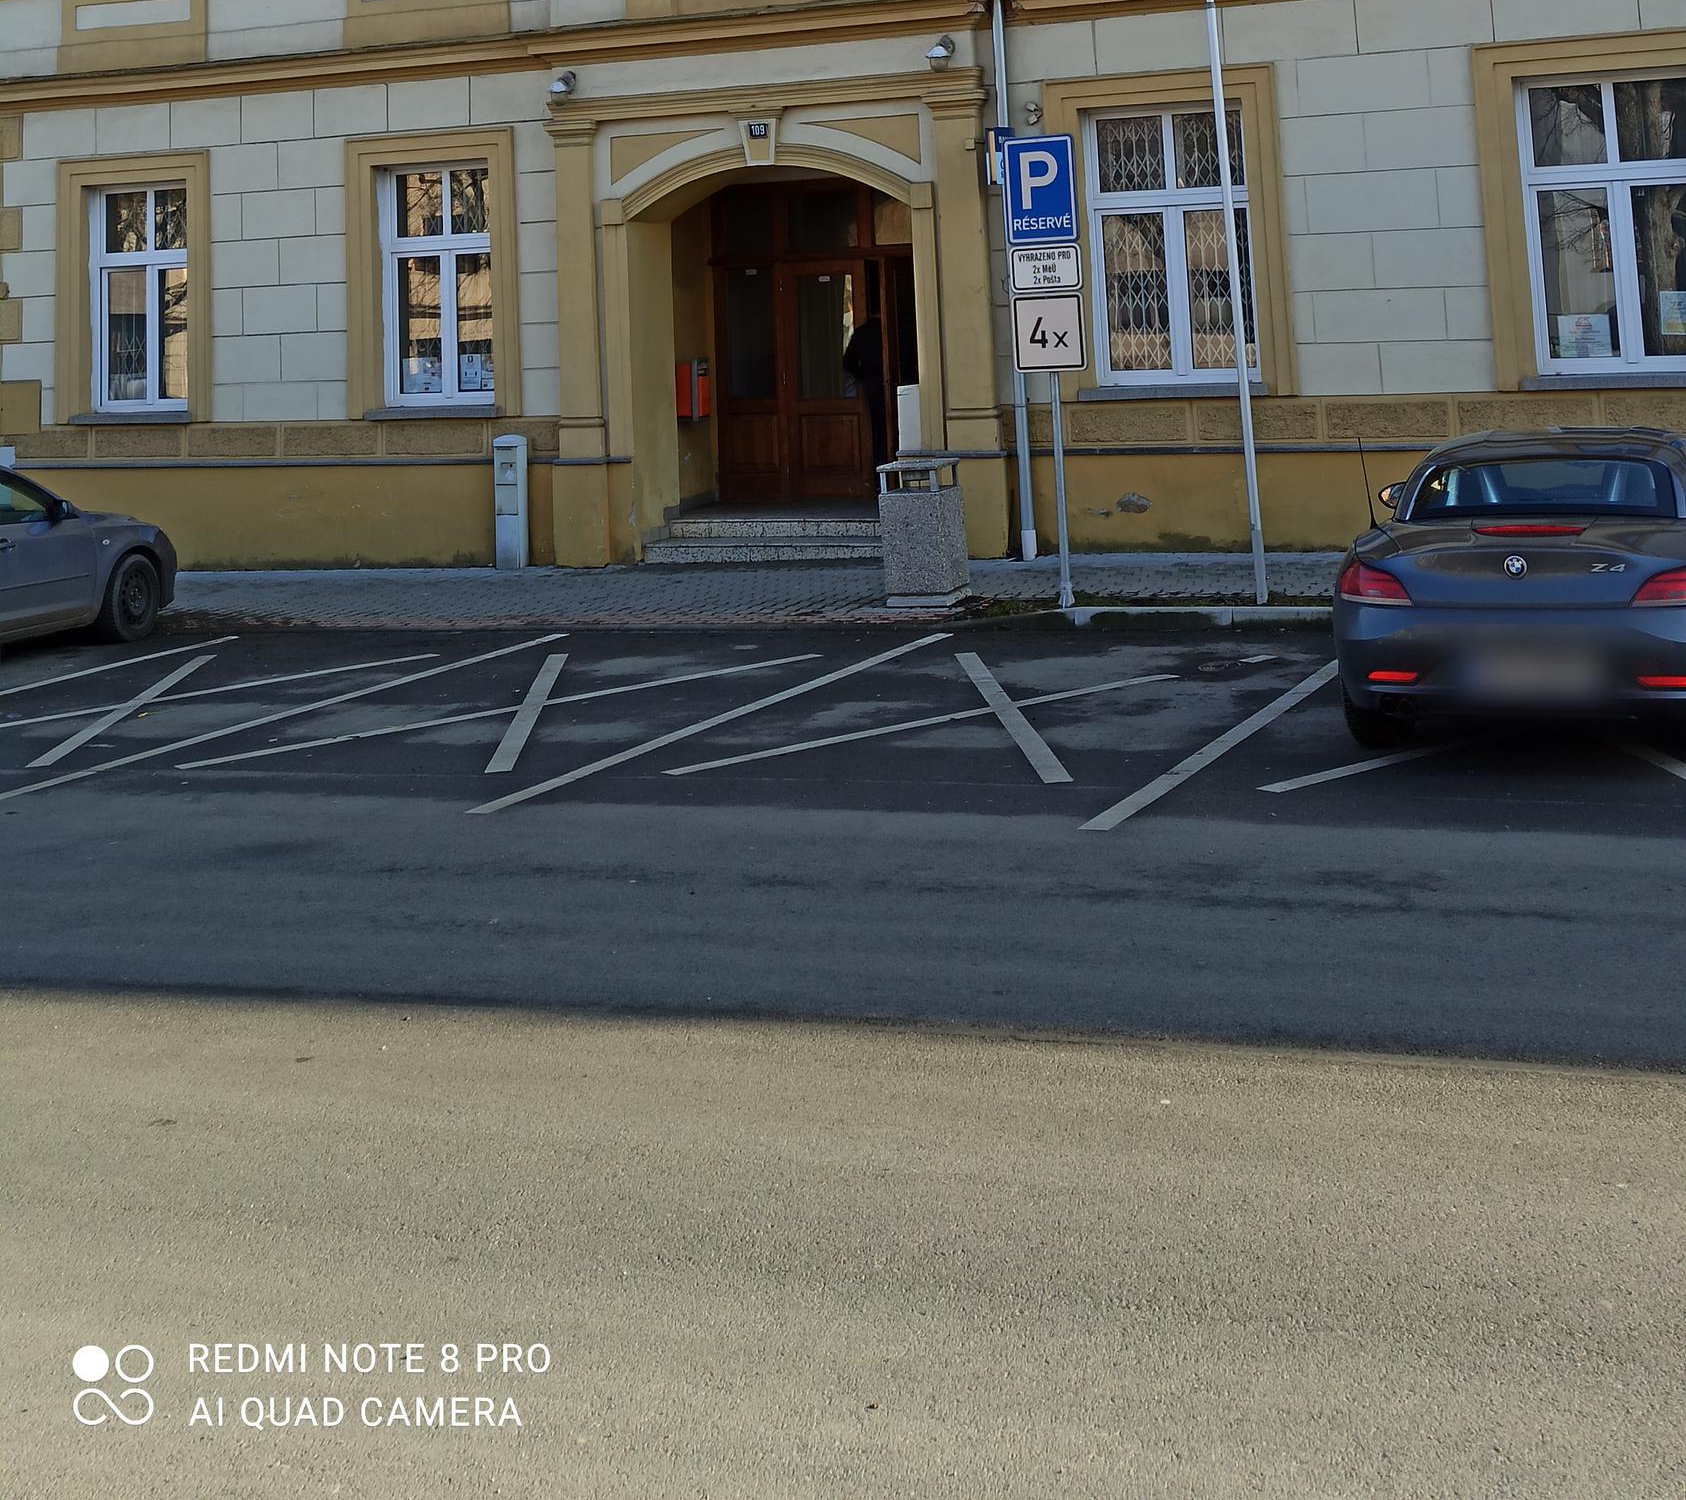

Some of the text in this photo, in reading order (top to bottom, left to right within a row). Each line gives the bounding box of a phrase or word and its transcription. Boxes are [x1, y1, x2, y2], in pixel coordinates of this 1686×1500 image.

[751, 125, 765, 135] 109
[1019, 151, 1058, 210] P
[1013, 213, 1072, 231] RÉSERVÉ
[1017, 250, 1072, 263] VYHRAZENO PRO
[1042, 275, 1061, 285] Pošta
